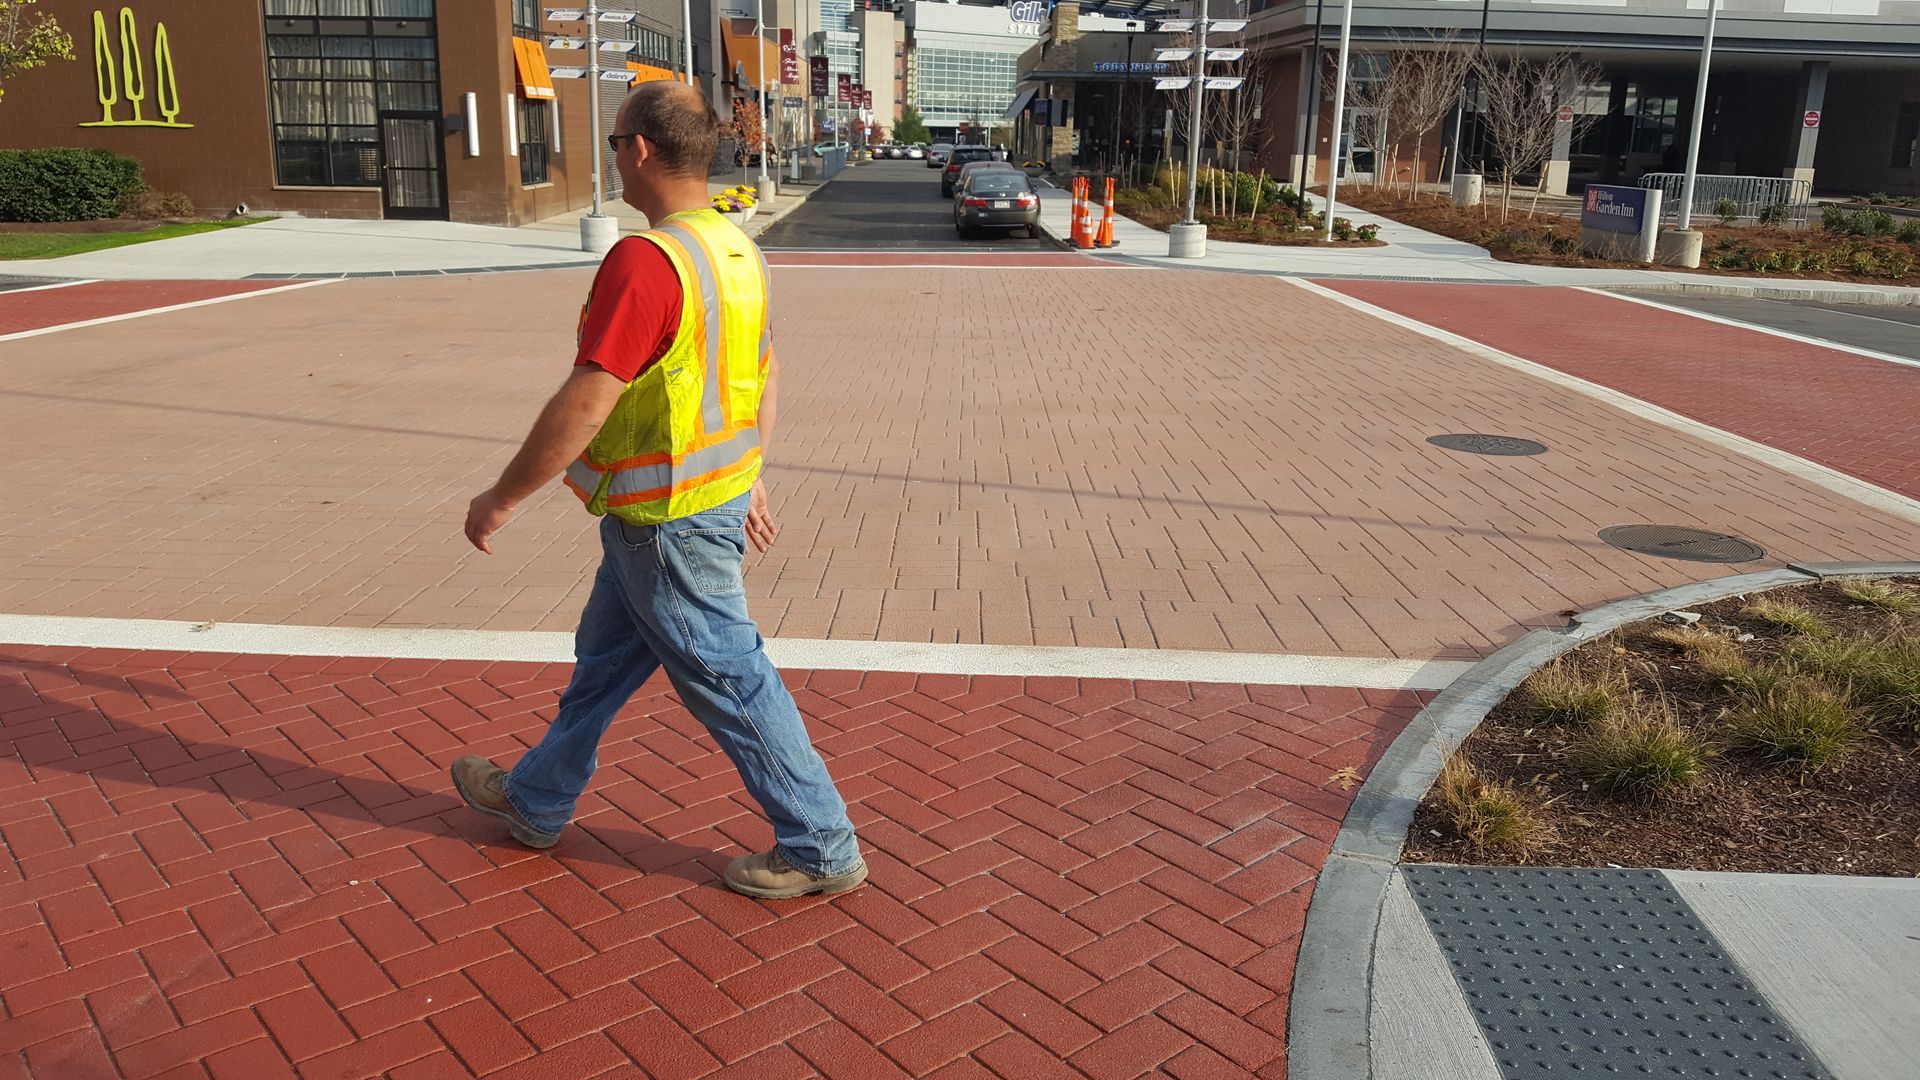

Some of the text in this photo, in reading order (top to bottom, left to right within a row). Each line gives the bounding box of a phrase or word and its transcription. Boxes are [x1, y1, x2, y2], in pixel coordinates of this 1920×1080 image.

[1011, 1, 1041, 23] Gill
[606, 72, 628, 80] claire's
[1596, 200, 1634, 217] Garden Inn
